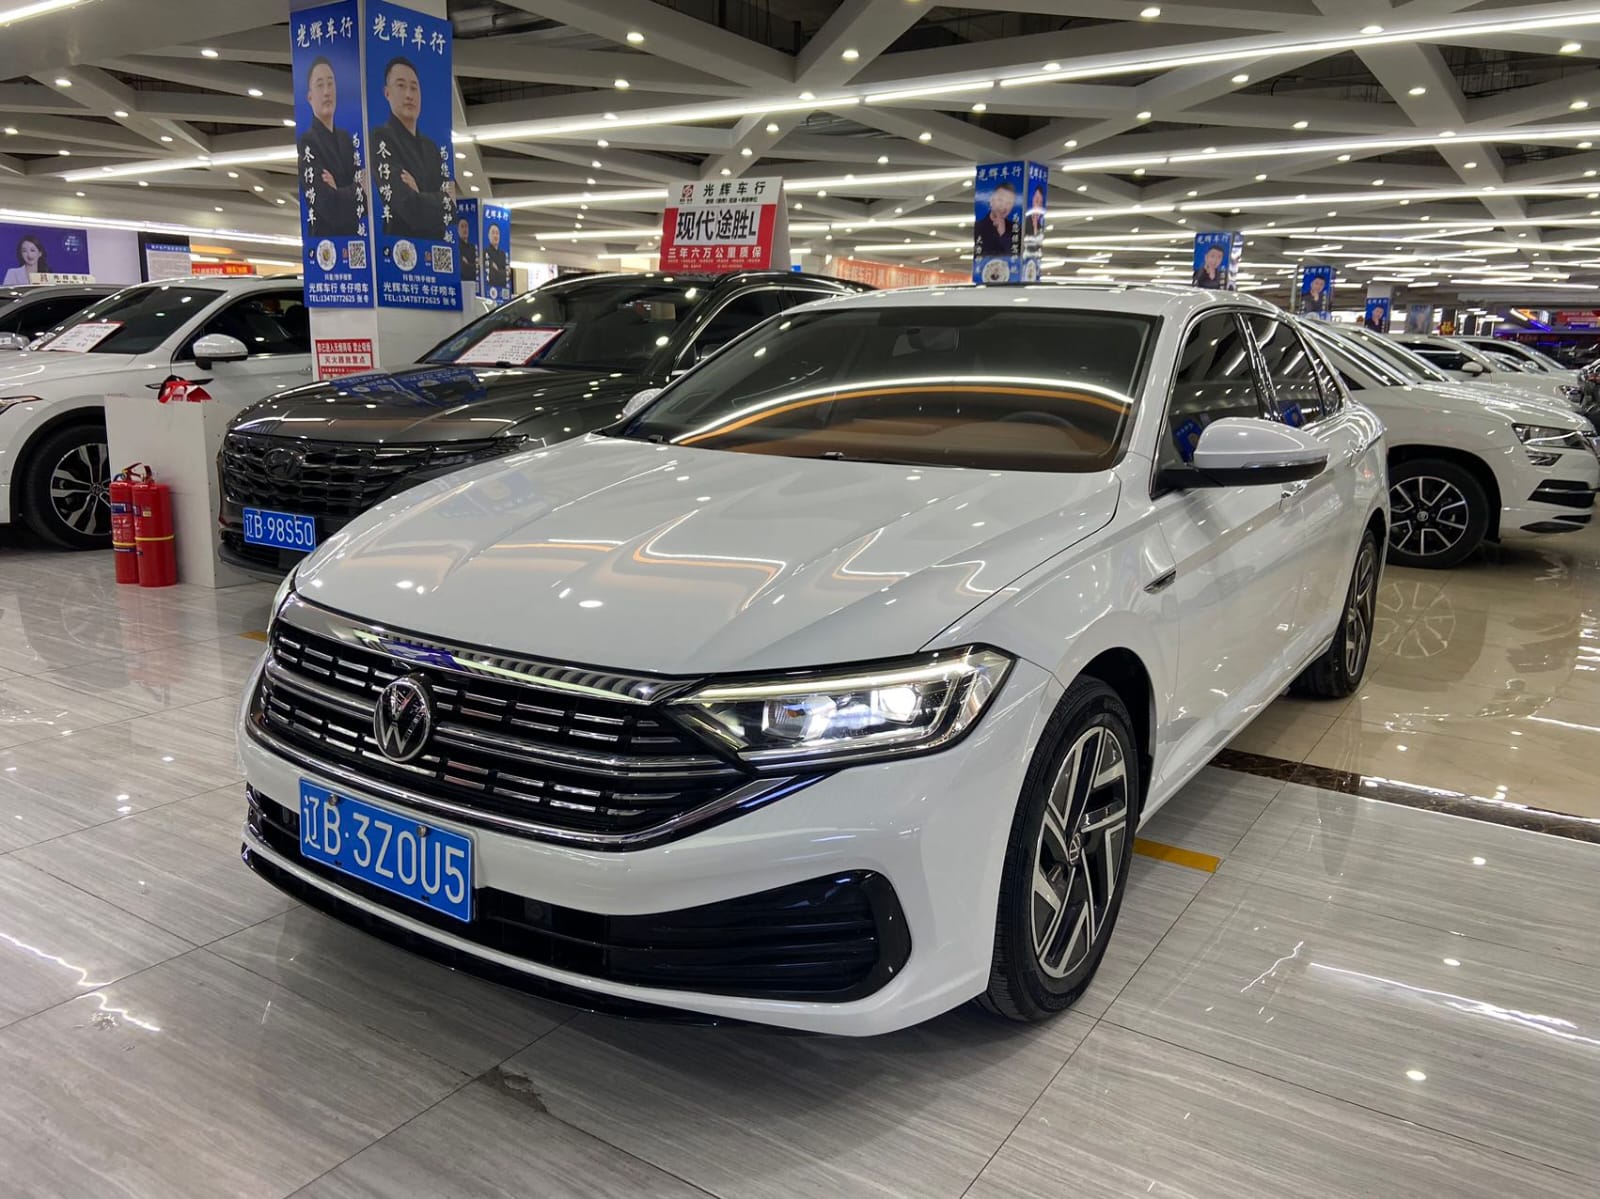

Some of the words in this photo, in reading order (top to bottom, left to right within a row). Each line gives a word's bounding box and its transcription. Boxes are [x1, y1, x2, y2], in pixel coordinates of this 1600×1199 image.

[296, 16, 353, 48] 光辉车行
[373, 13, 446, 55] 光辉车行
[703, 181, 766, 197] 光辉车行
[676, 208, 757, 241] 现代途胜L
[245, 513, 313, 545] 辽B·98S50
[304, 795, 465, 904] 辽B·3Z0U5
